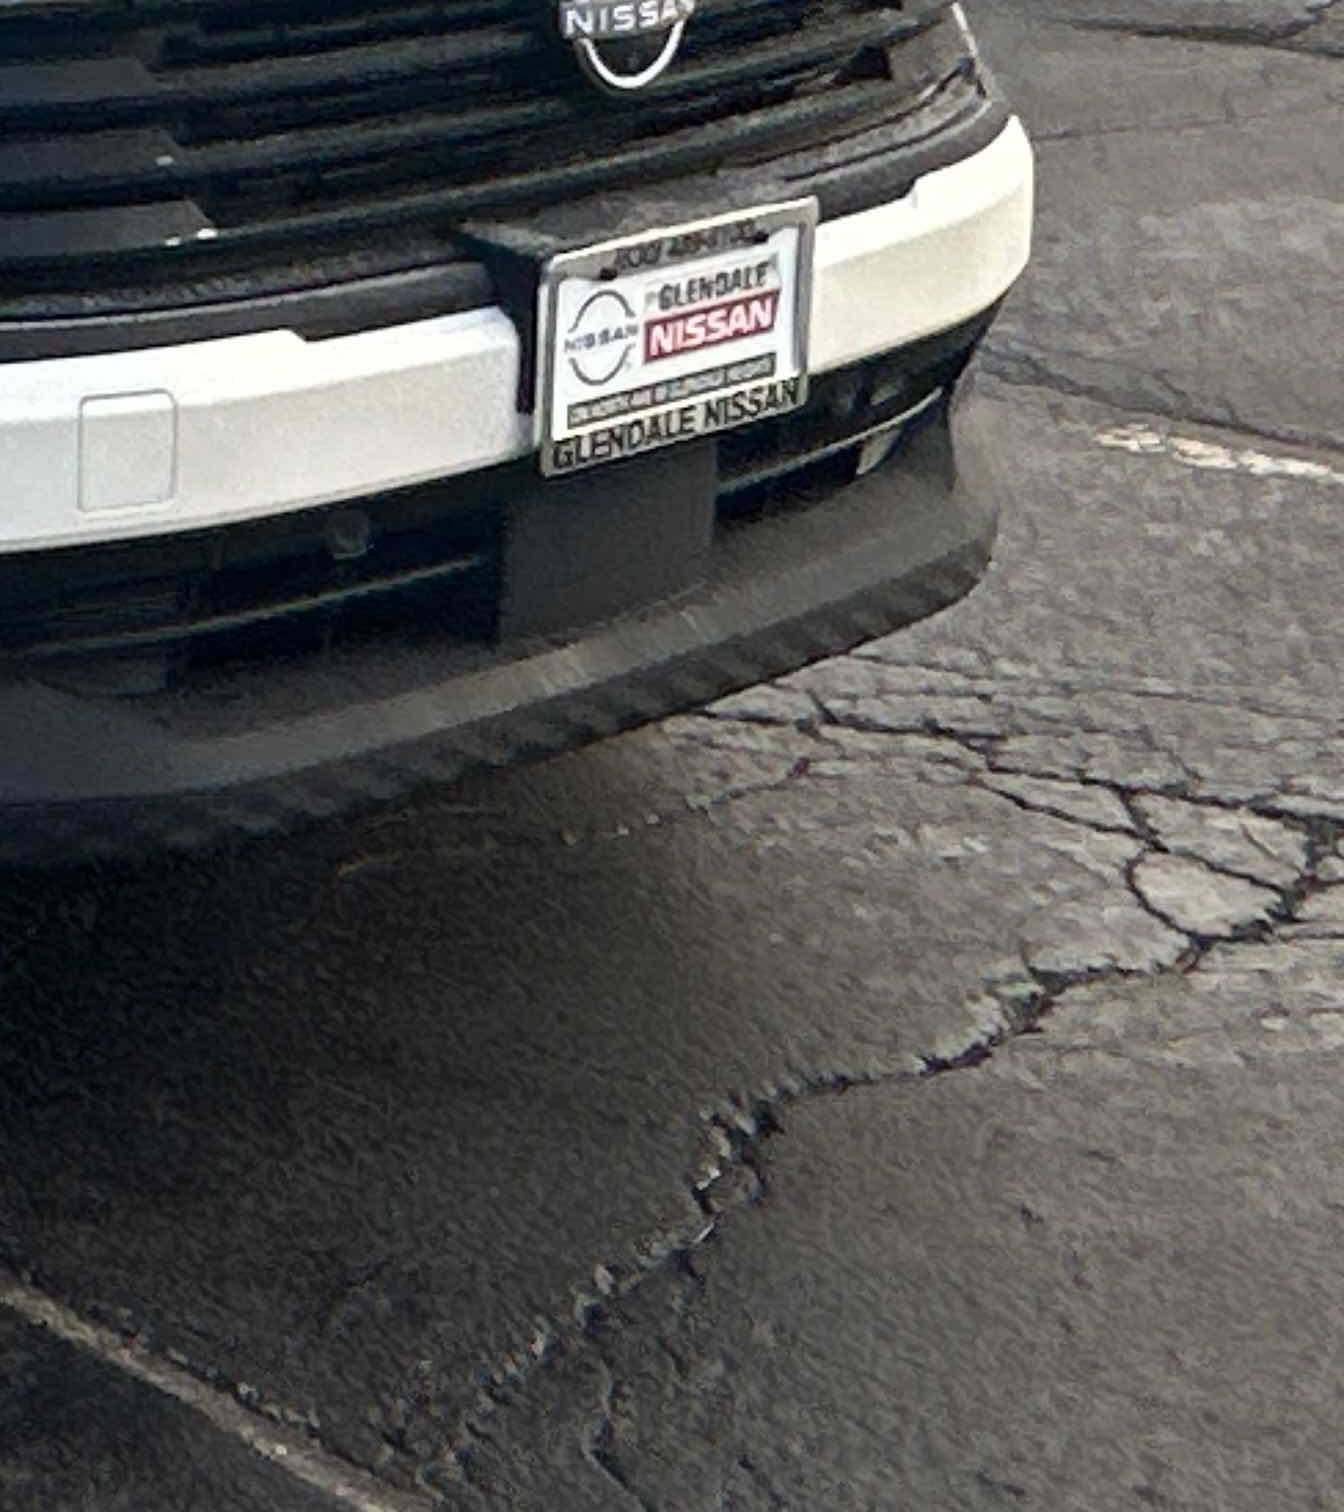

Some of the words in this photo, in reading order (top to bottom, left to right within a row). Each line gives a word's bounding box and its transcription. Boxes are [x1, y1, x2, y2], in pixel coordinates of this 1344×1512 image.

[656, 262, 770, 310] GLENDALE
[650, 296, 774, 358] NISSAN
[553, 406, 696, 469] GLENDALE
[702, 376, 800, 427] NISSAN
